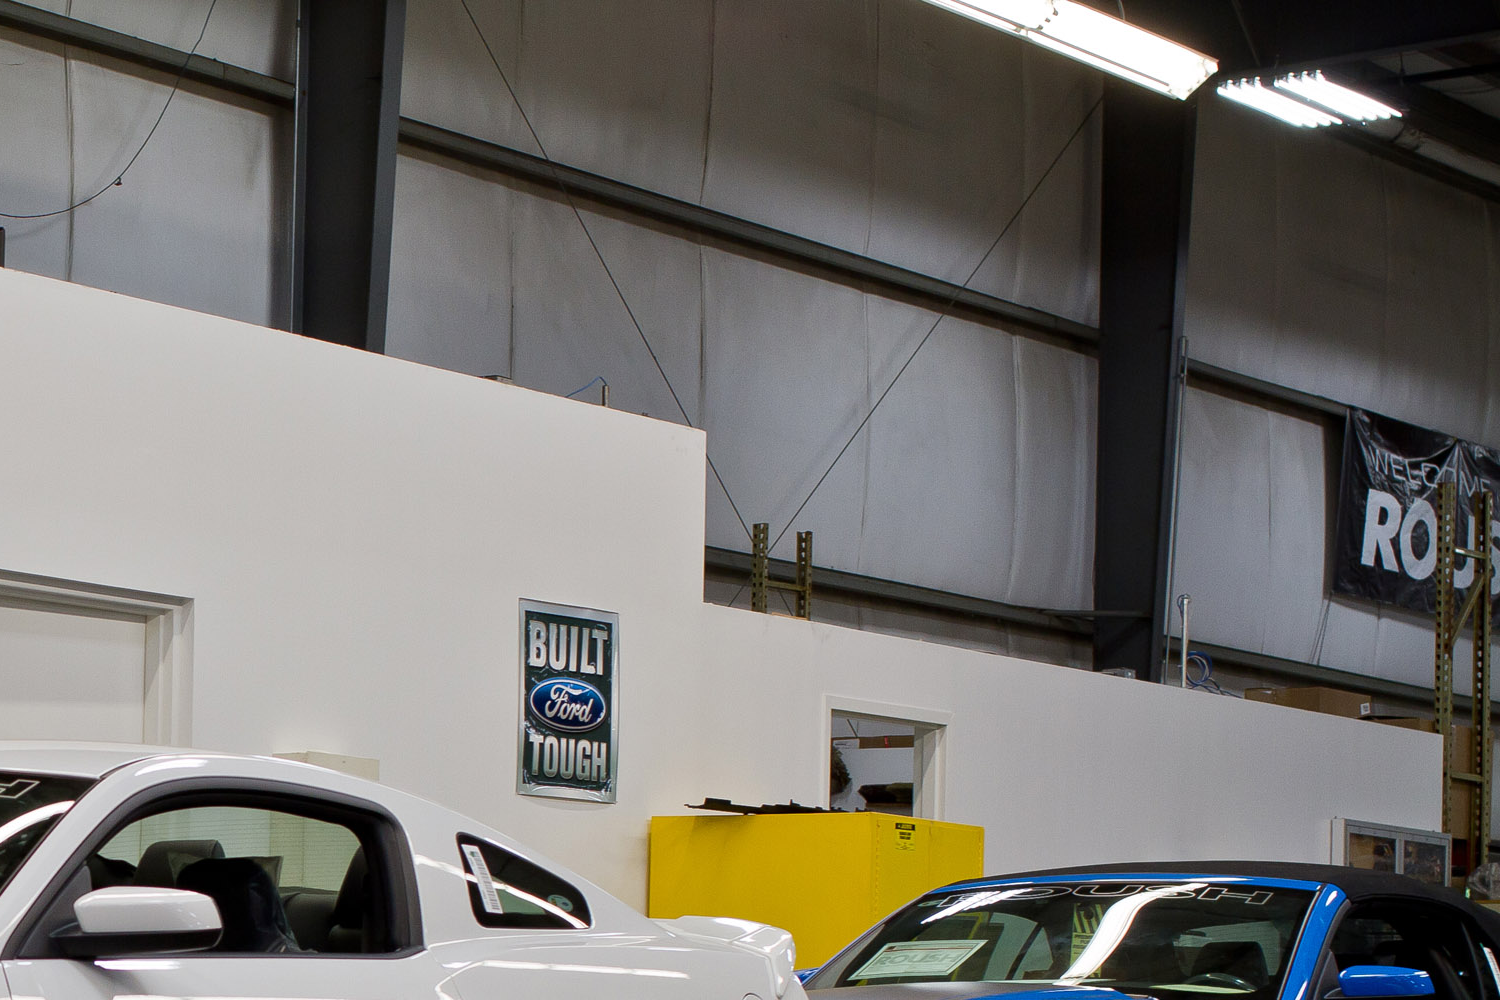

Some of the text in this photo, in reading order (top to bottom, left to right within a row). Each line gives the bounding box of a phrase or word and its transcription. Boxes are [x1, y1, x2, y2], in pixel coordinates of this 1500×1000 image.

[529, 620, 608, 675] BUILT
[545, 684, 593, 722] Ford
[528, 733, 608, 783] TOUGH
